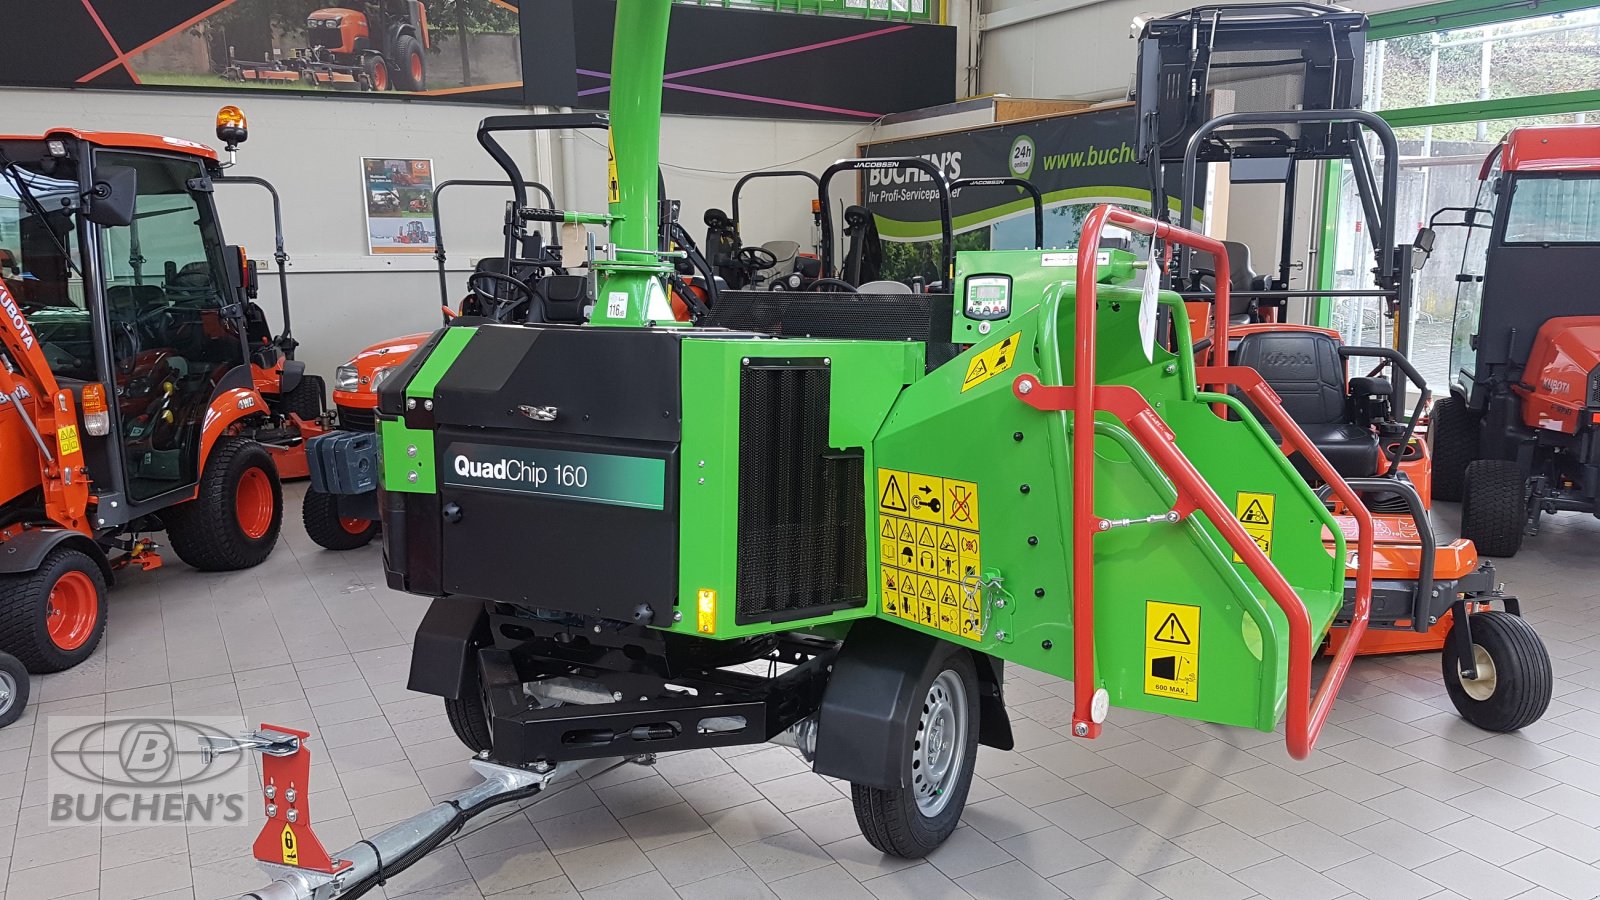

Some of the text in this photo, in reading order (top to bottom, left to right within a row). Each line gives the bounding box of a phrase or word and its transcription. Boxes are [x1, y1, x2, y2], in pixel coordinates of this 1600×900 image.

[1014, 146, 1031, 159] 24h
[869, 187, 961, 203] Ihr Profi-Servicepaer
[609, 304, 620, 317] 116
[0, 286, 33, 350] UBOTA
[1543, 377, 1570, 393] KUBOTA
[237, 397, 255, 410] 4WD
[454, 455, 587, 487] QuadChip 160
[1170, 686, 1185, 694] MAX
